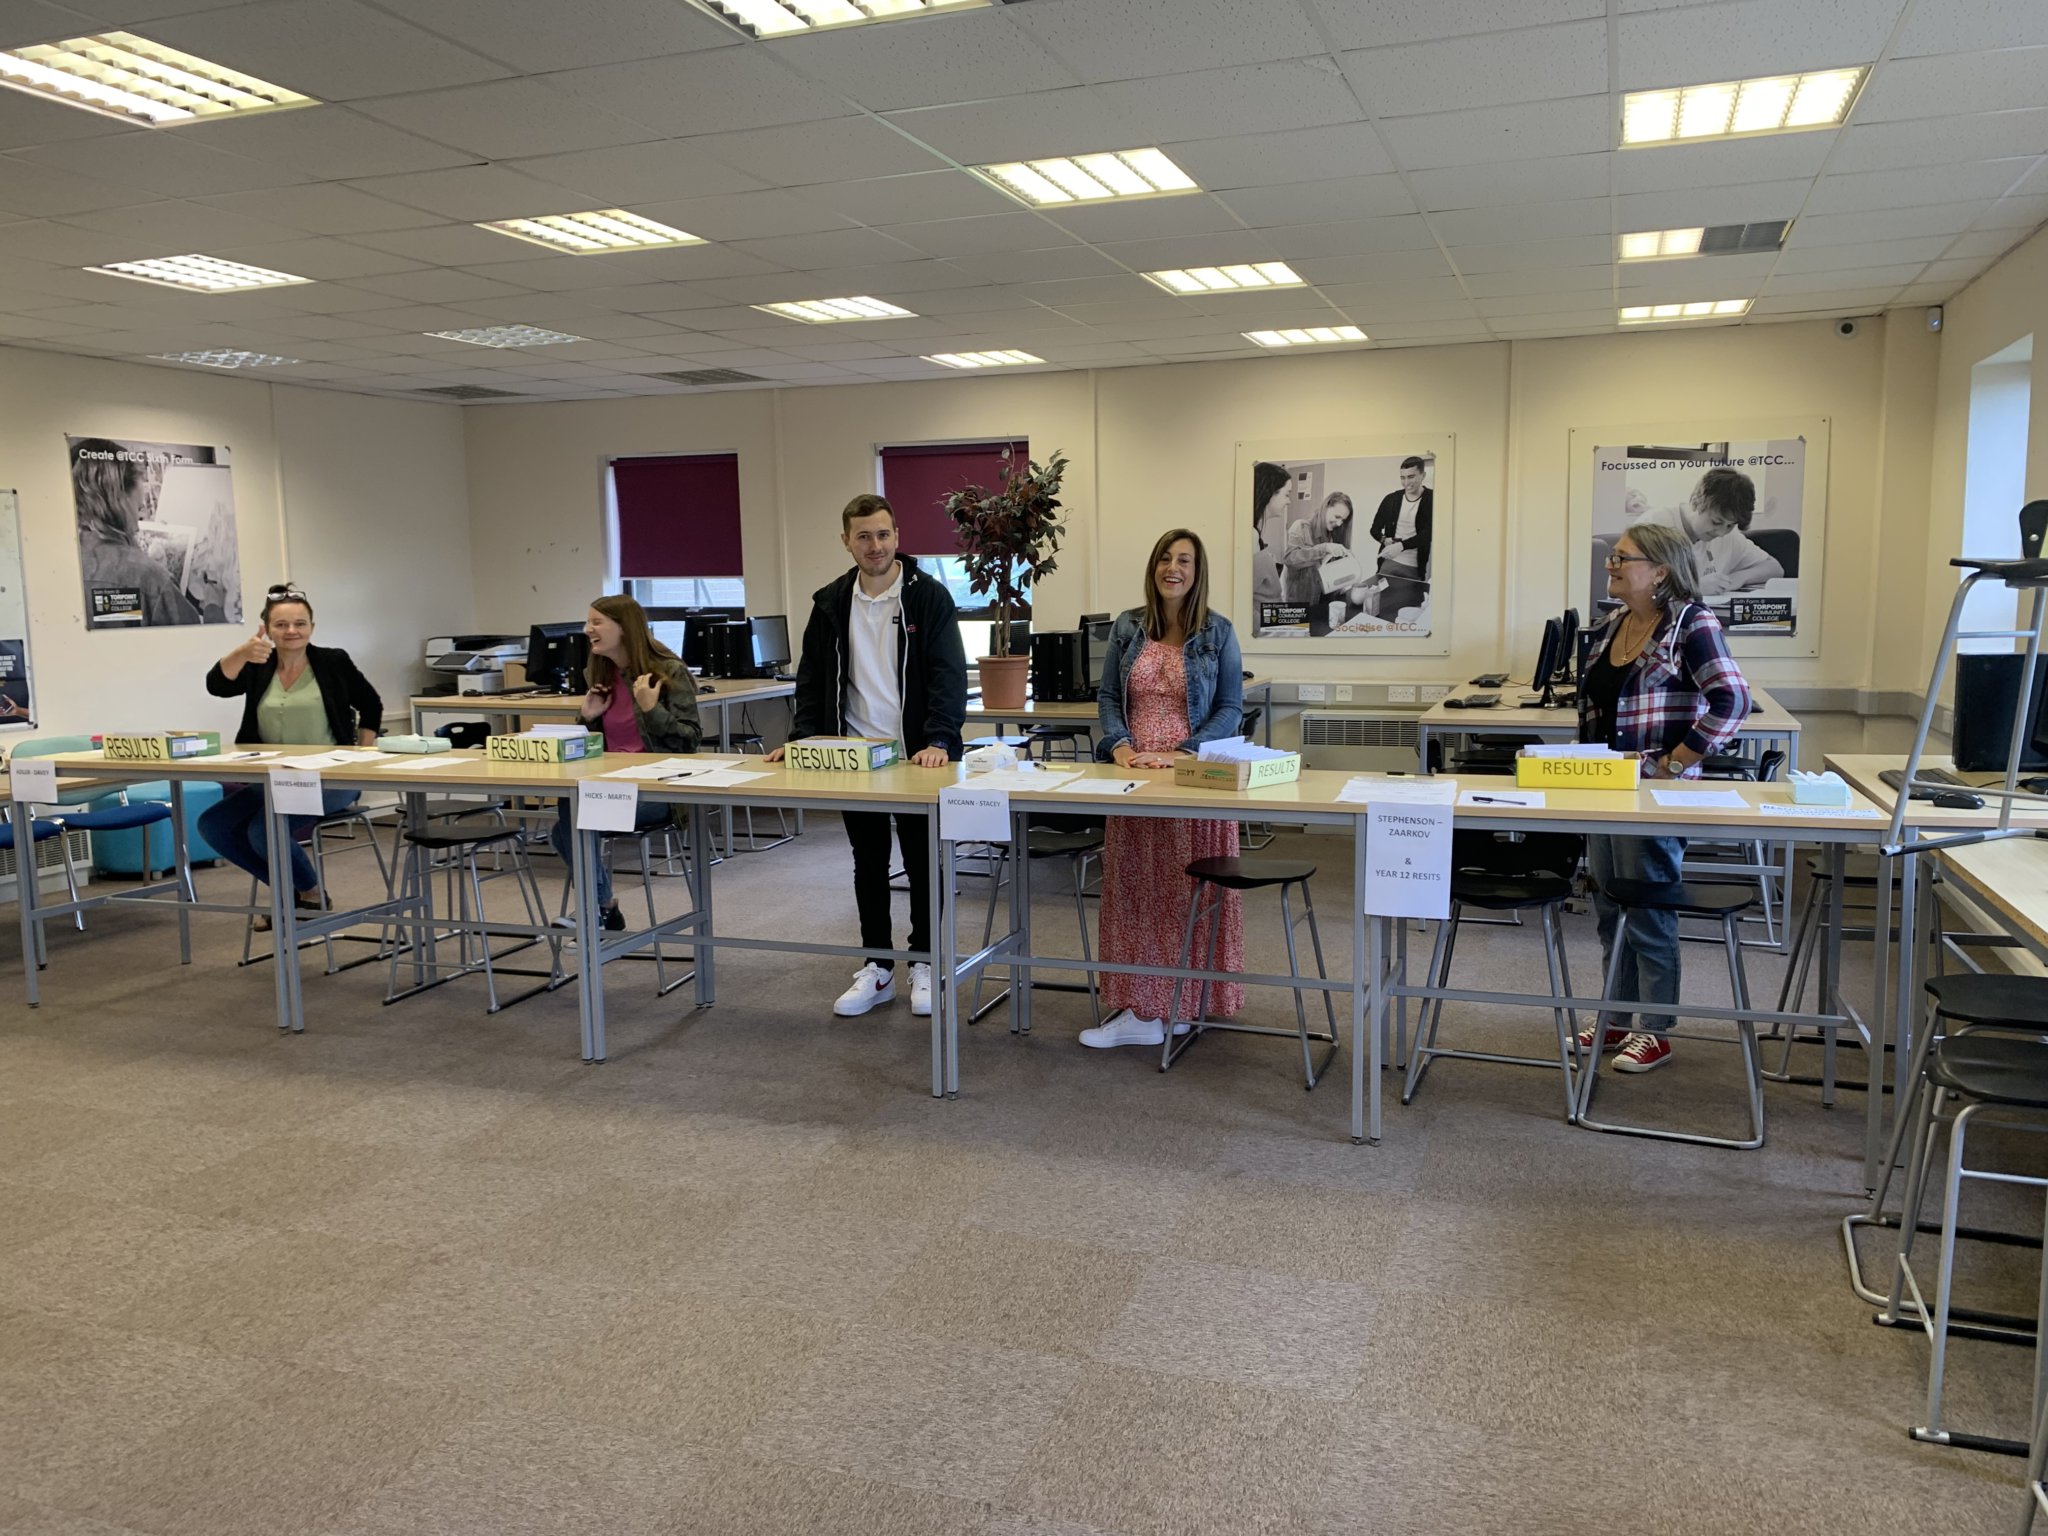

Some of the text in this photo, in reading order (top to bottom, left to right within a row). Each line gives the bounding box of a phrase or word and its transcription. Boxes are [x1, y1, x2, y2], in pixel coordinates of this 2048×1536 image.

[79, 448, 194, 464] Create @TCC Sixth Form
[1601, 460, 1657, 471] Focussed
[1679, 459, 1706, 472] your
[1709, 457, 1745, 467] future
[1748, 455, 1795, 466] @TCC...
[1386, 622, 1427, 632] @TCC...
[106, 737, 160, 759] RESULTS
[491, 737, 550, 762] RESULTS
[790, 746, 859, 771] RESULTS
[1258, 760, 1296, 778] RESULTS
[1542, 762, 1613, 776] RESULTS
[584, 792, 603, 800] HICKS
[607, 793, 632, 801] MARTIN
[1378, 815, 1436, 826] STEPHENSON
[1389, 828, 1431, 838] ZAARKOV
[1404, 857, 1413, 866] &
[1375, 869, 1441, 881] YEAR 12 RESITS
